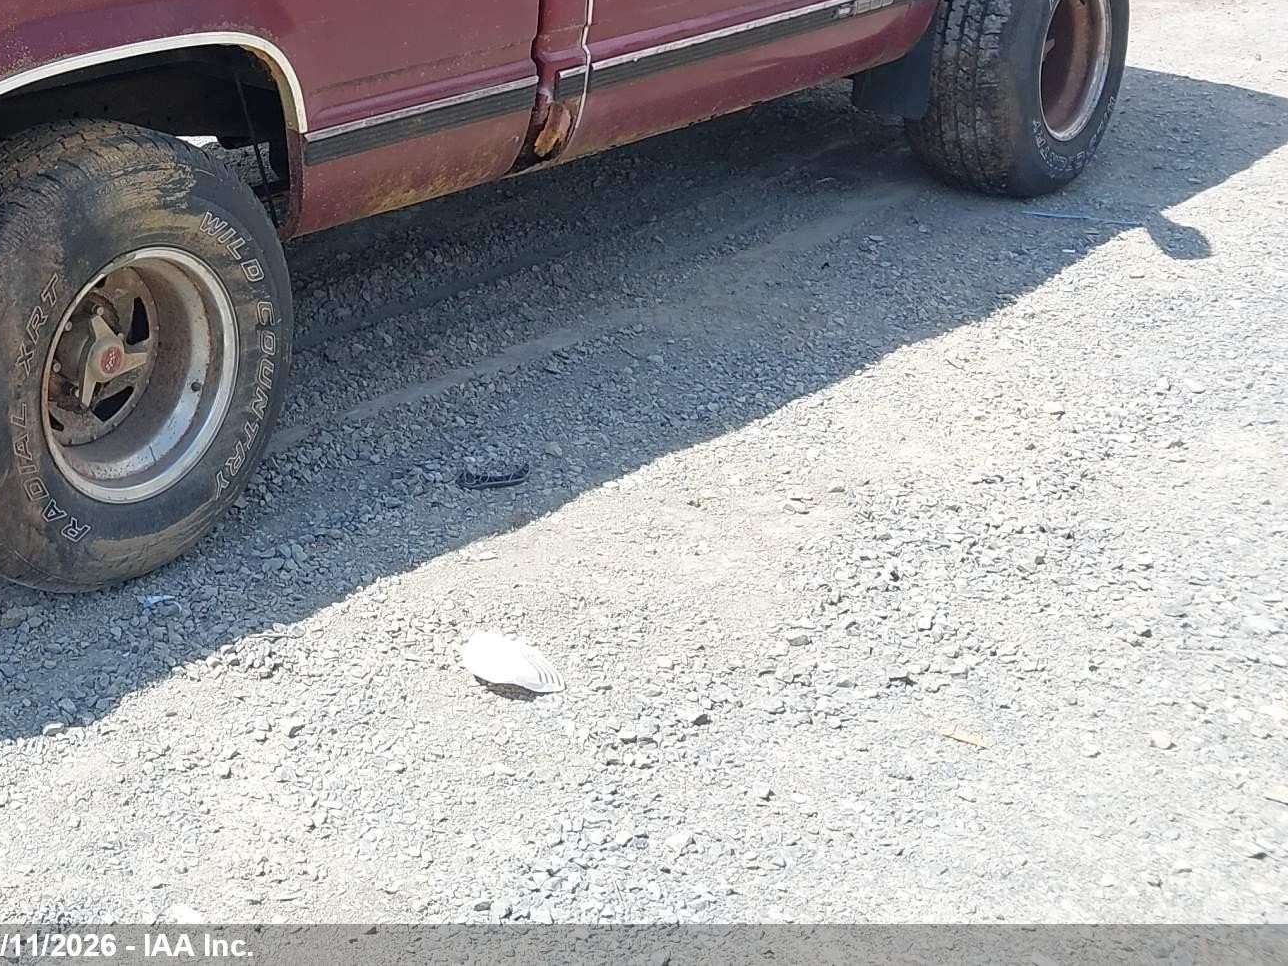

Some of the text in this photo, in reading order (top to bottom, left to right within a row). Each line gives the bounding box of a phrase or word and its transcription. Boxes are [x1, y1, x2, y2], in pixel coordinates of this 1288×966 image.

[11, 272, 92, 543] RADIAL XRT
[198, 210, 276, 499] WILD COUNTRY
